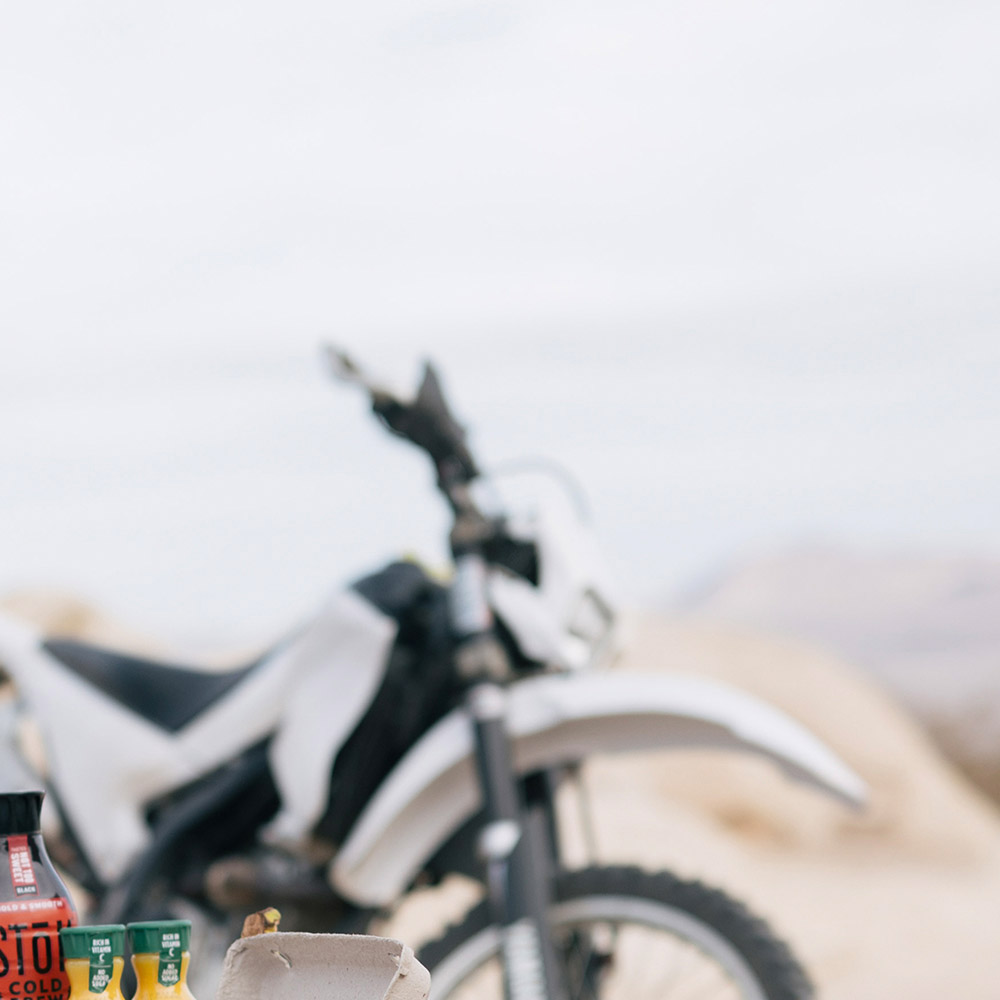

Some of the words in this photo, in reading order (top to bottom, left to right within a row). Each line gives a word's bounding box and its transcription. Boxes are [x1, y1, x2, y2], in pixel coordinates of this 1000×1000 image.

[19, 851, 31, 868] NOT
[10, 853, 24, 883] SWEET
[22, 868, 35, 883] TOO
[16, 886, 36, 894] BLACK
[99, 953, 105, 961] C
[168, 948, 174, 957] C
[9, 978, 62, 995] COLD
